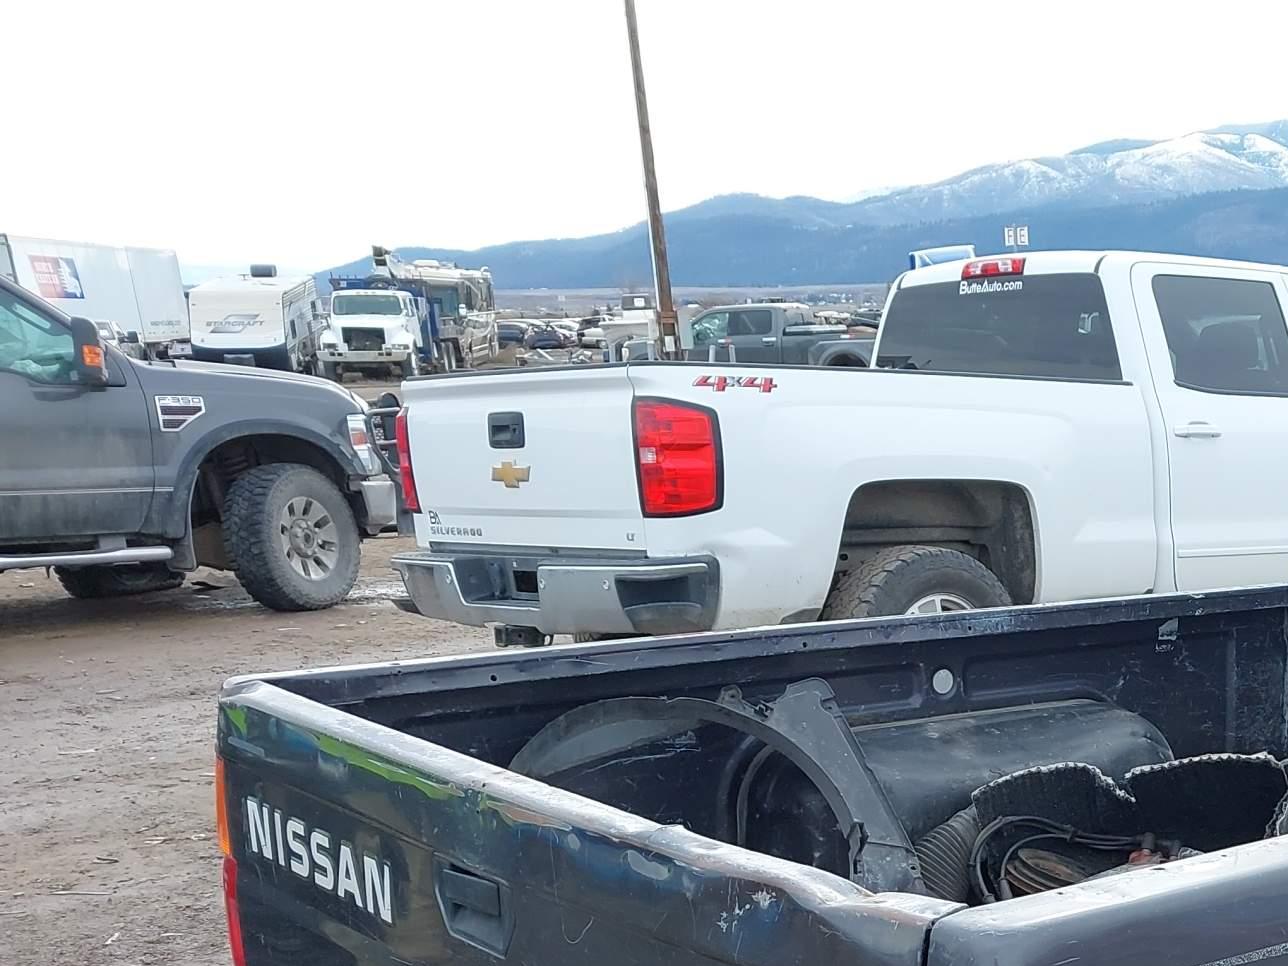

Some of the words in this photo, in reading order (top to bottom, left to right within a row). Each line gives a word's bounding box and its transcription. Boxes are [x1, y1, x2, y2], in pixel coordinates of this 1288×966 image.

[959, 279, 1023, 295] ButteAuto.com
[430, 526, 483, 537] SILVERADO
[246, 797, 393, 924] NISSAN
